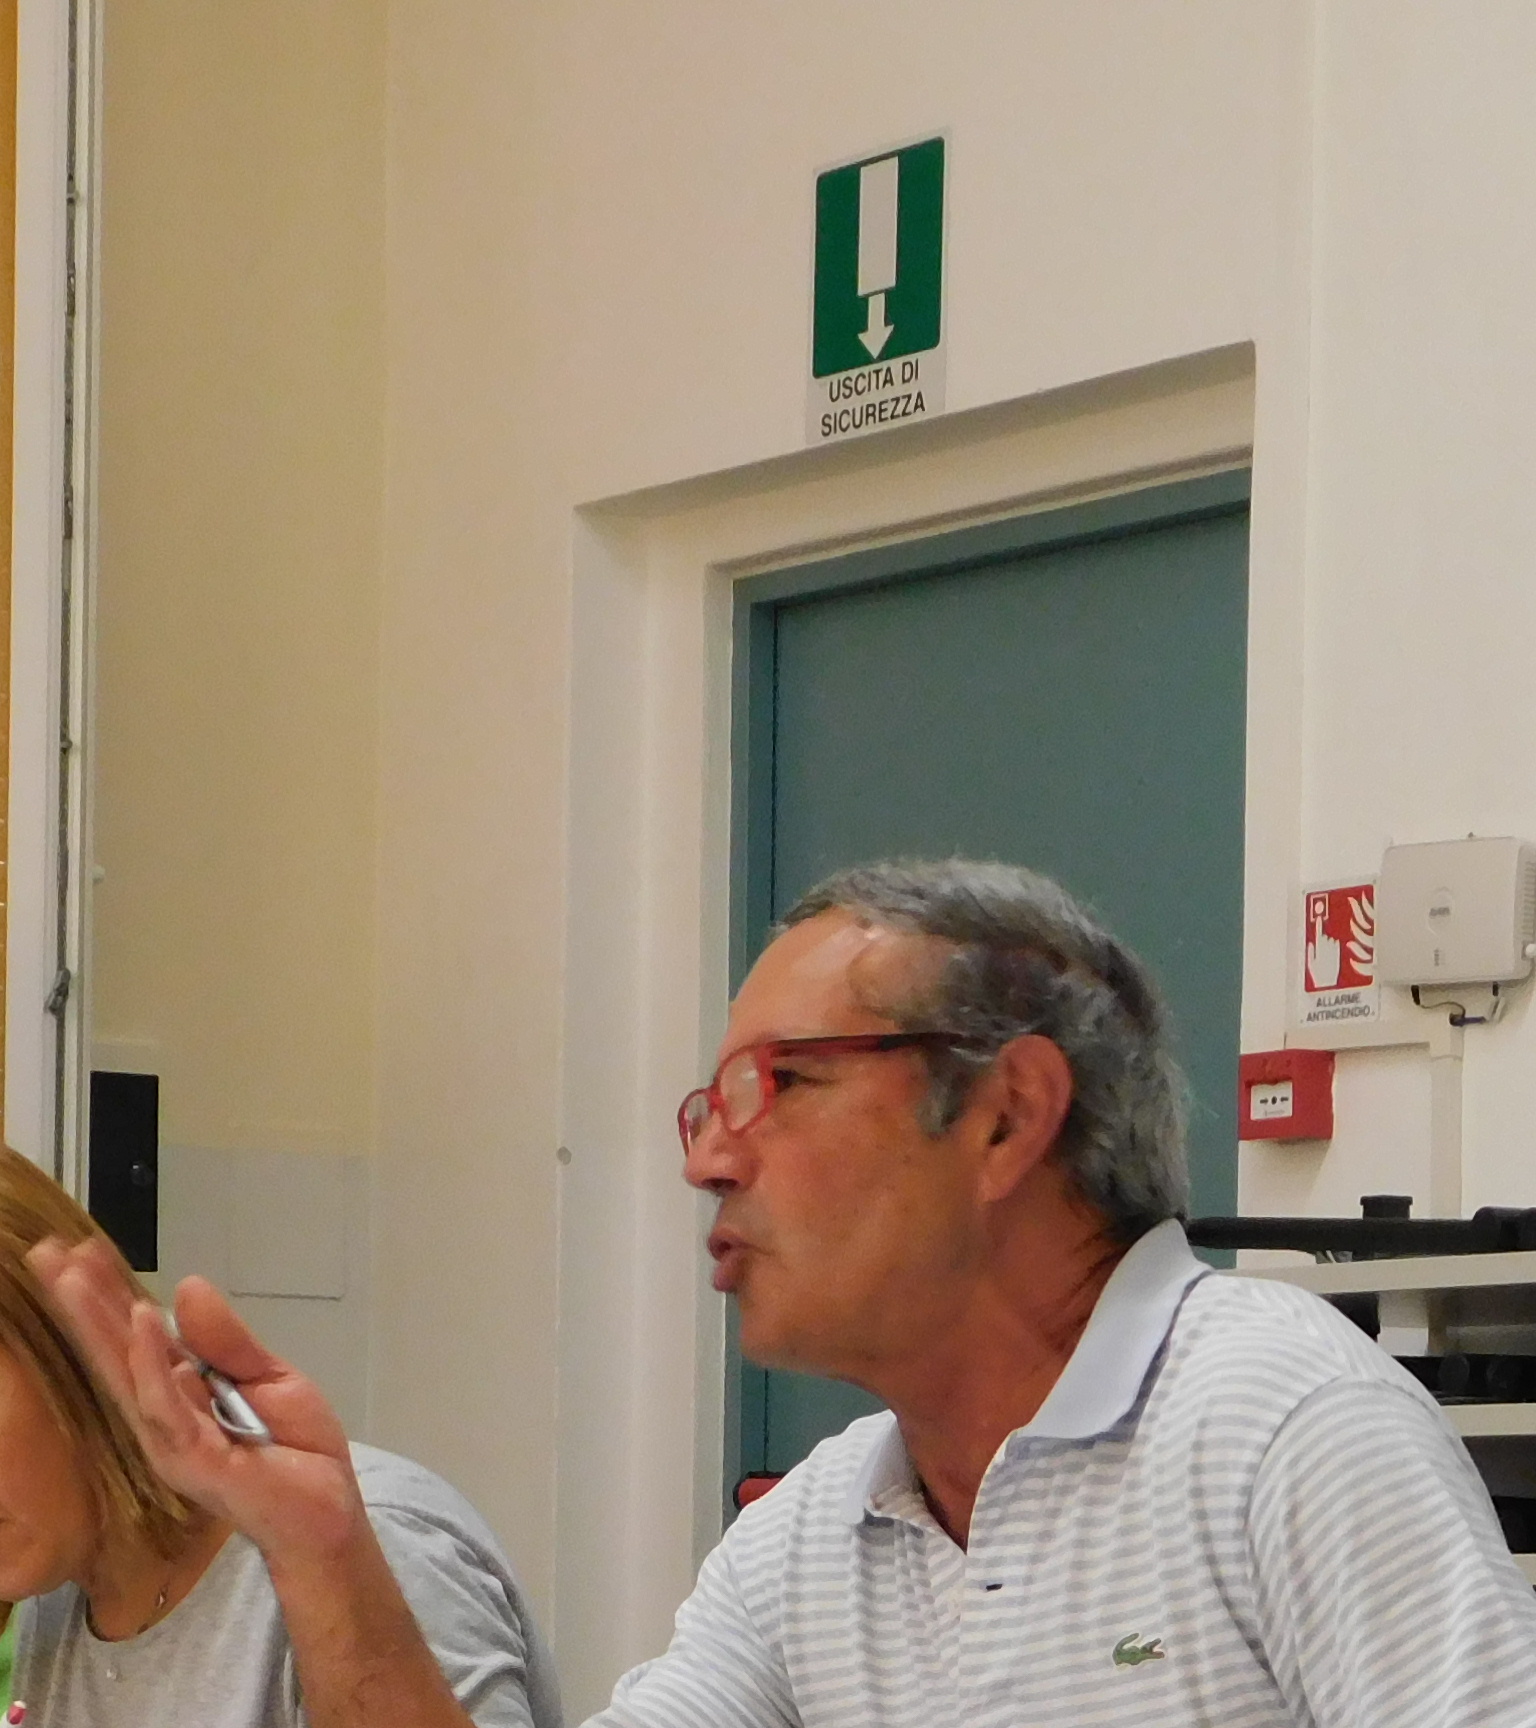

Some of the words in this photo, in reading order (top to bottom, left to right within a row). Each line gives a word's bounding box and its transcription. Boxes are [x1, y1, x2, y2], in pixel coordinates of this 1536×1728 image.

[828, 363, 895, 403] USCITA
[902, 359, 920, 384] DI
[820, 391, 926, 437] SICUREZZA
[1306, 1005, 1371, 1022] ANTINCENDIO
[1316, 992, 1361, 1007] ALLARME
